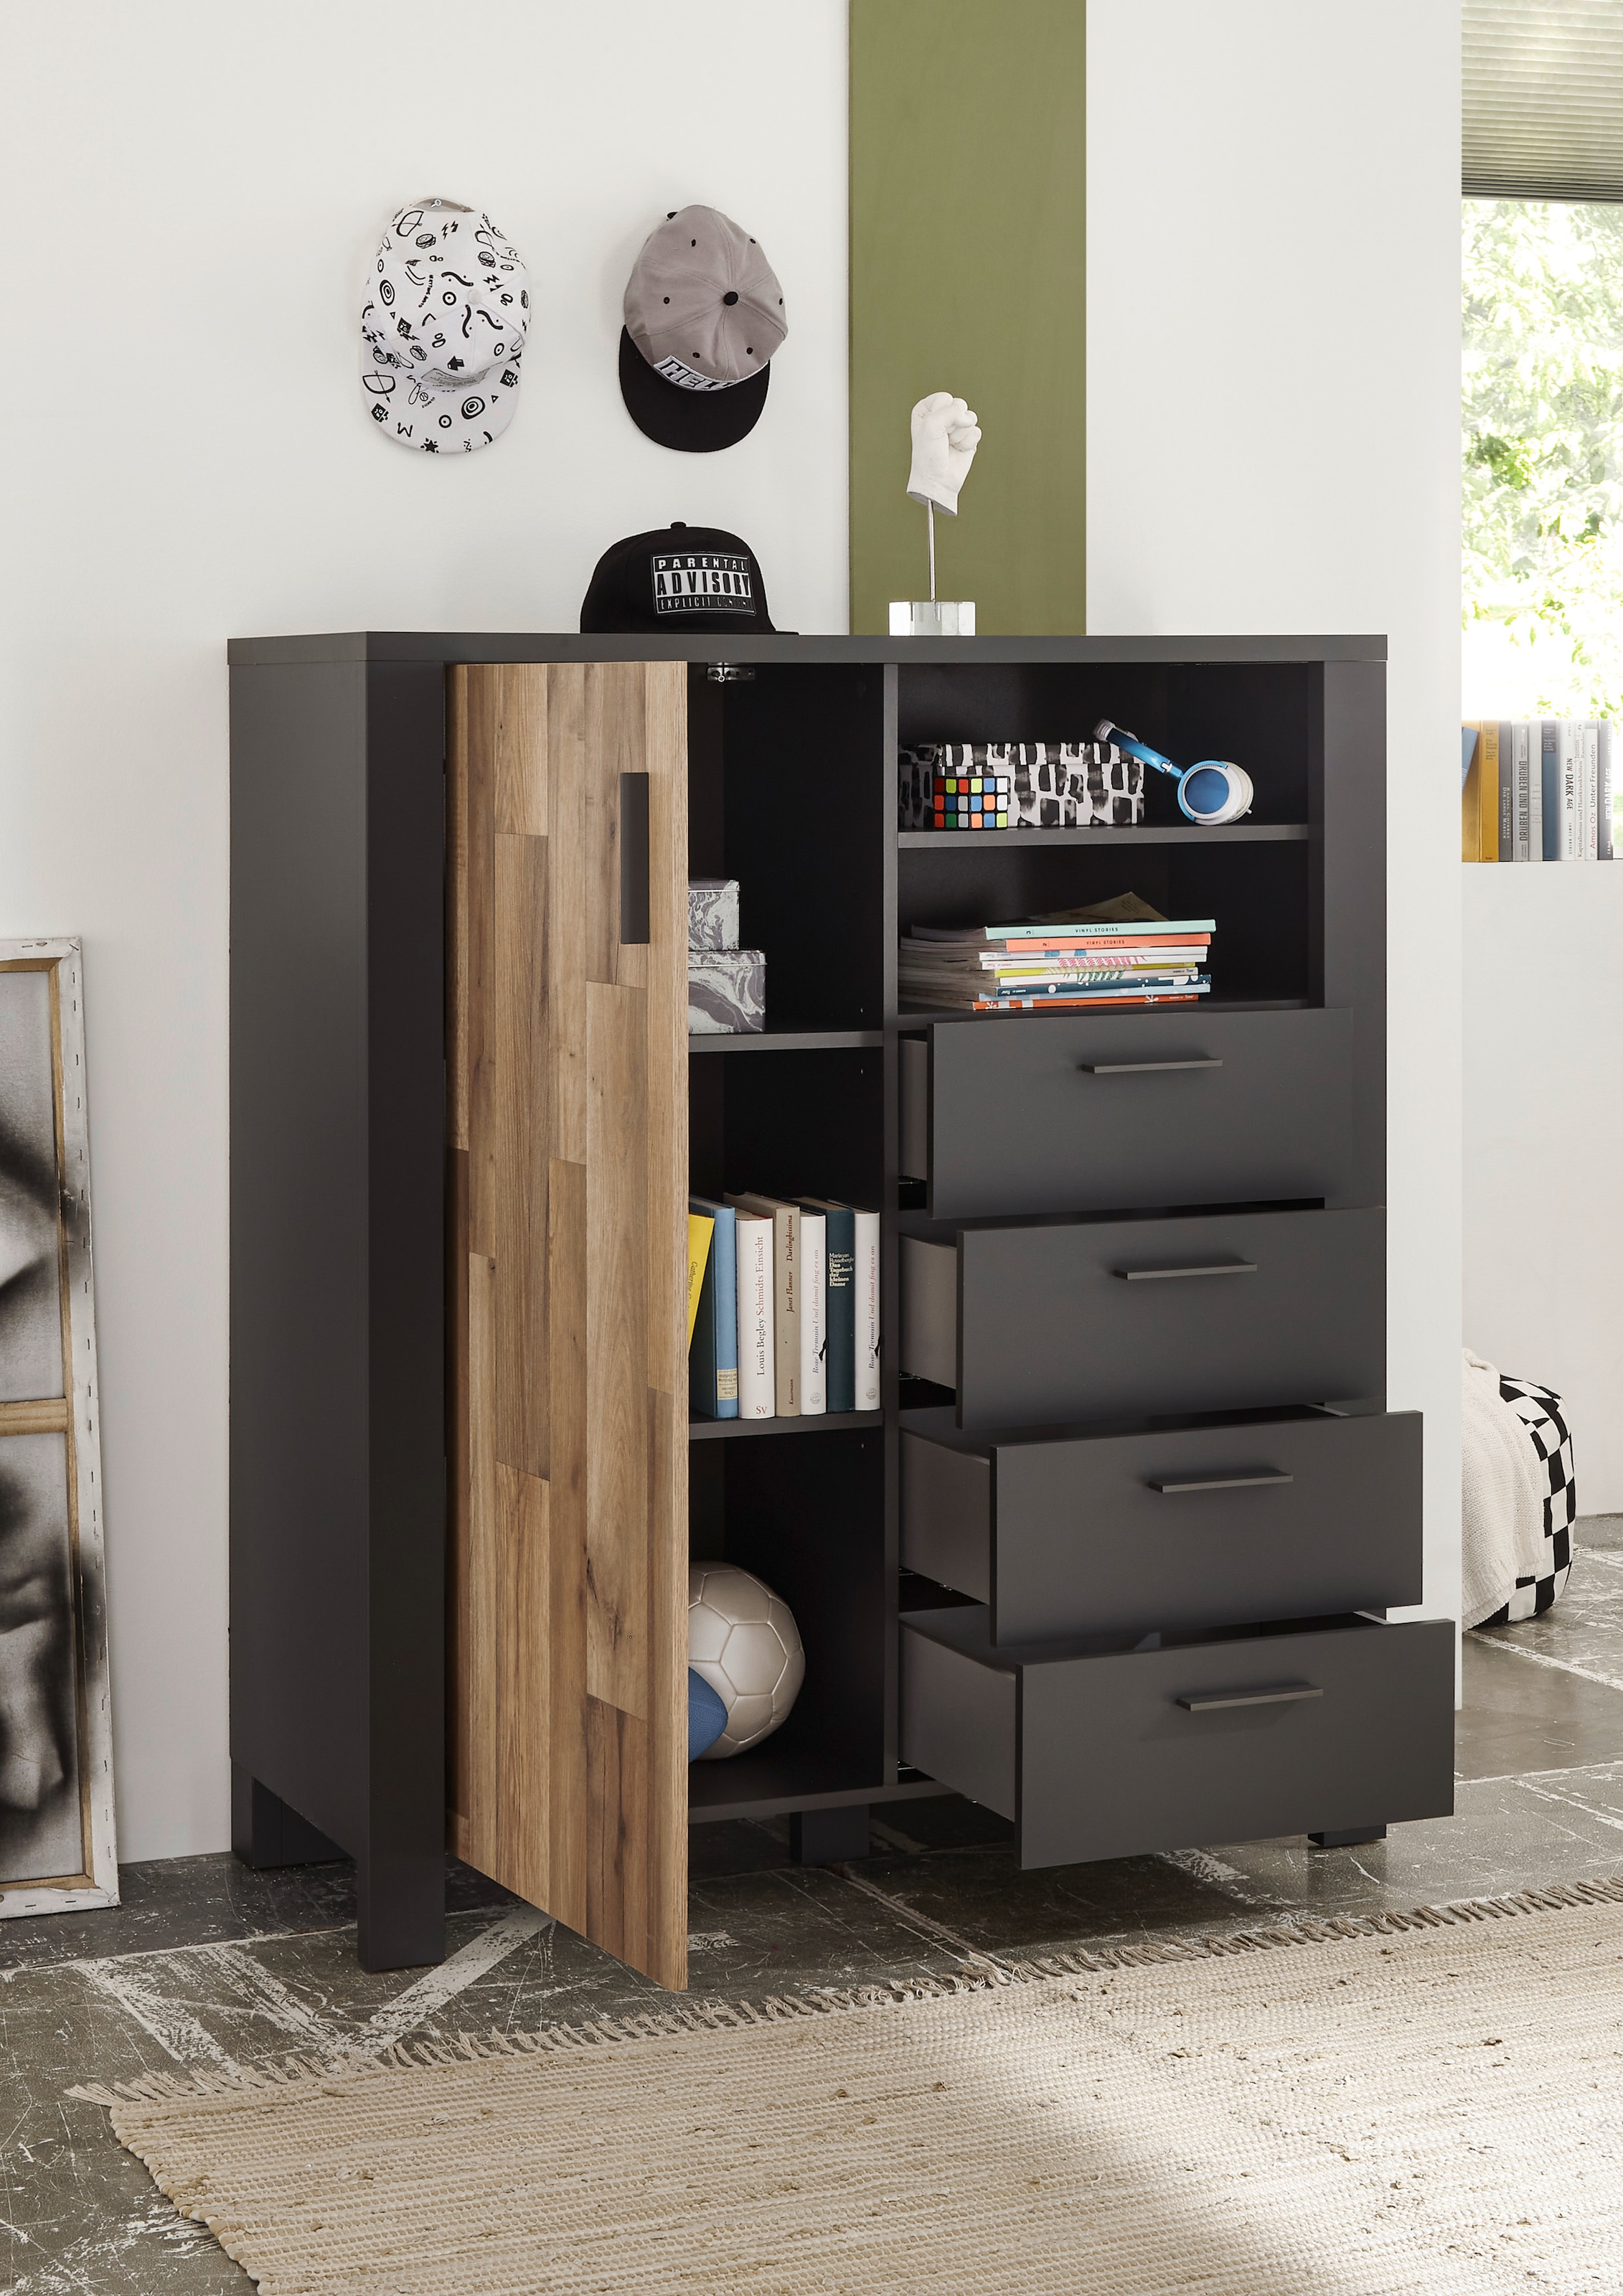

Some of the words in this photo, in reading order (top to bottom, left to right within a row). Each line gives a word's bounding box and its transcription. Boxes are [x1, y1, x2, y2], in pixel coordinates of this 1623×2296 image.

[658, 557, 745, 570] PARENTAL
[657, 571, 749, 596] ADVISORY
[661, 597, 710, 609] EXPLICIT
[1590, 812, 1596, 824] Oz
[755, 1236, 763, 1272] Einsicht
[814, 1250, 819, 1259] an
[870, 1246, 875, 1256] an
[812, 1270, 820, 1285] fing
[756, 1275, 764, 1316] Schmidts
[786, 1297, 795, 1313] Janet
[756, 1319, 766, 1347] Begley
[756, 1406, 767, 1414] SV
